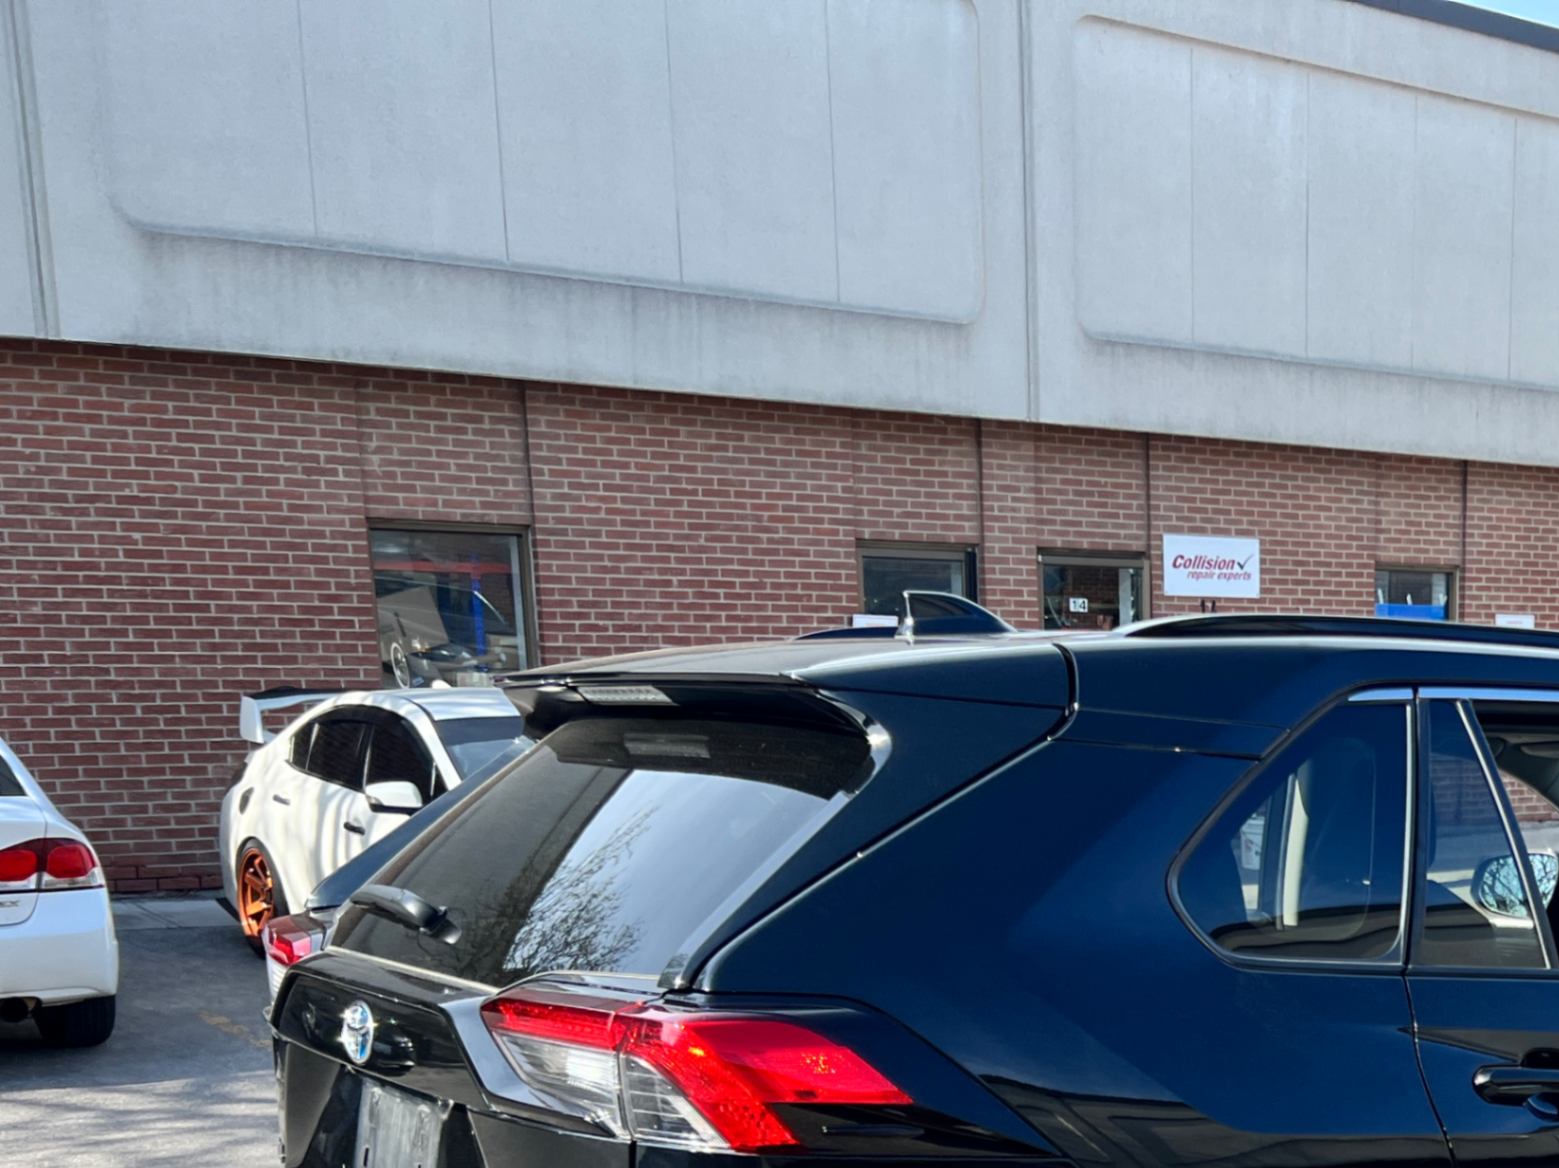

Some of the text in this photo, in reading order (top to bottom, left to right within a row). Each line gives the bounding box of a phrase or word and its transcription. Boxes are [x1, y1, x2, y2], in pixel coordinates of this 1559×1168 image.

[1172, 554, 1235, 570] Collision
[1187, 571, 1251, 581] repair experts
[1072, 600, 1086, 611] 14
